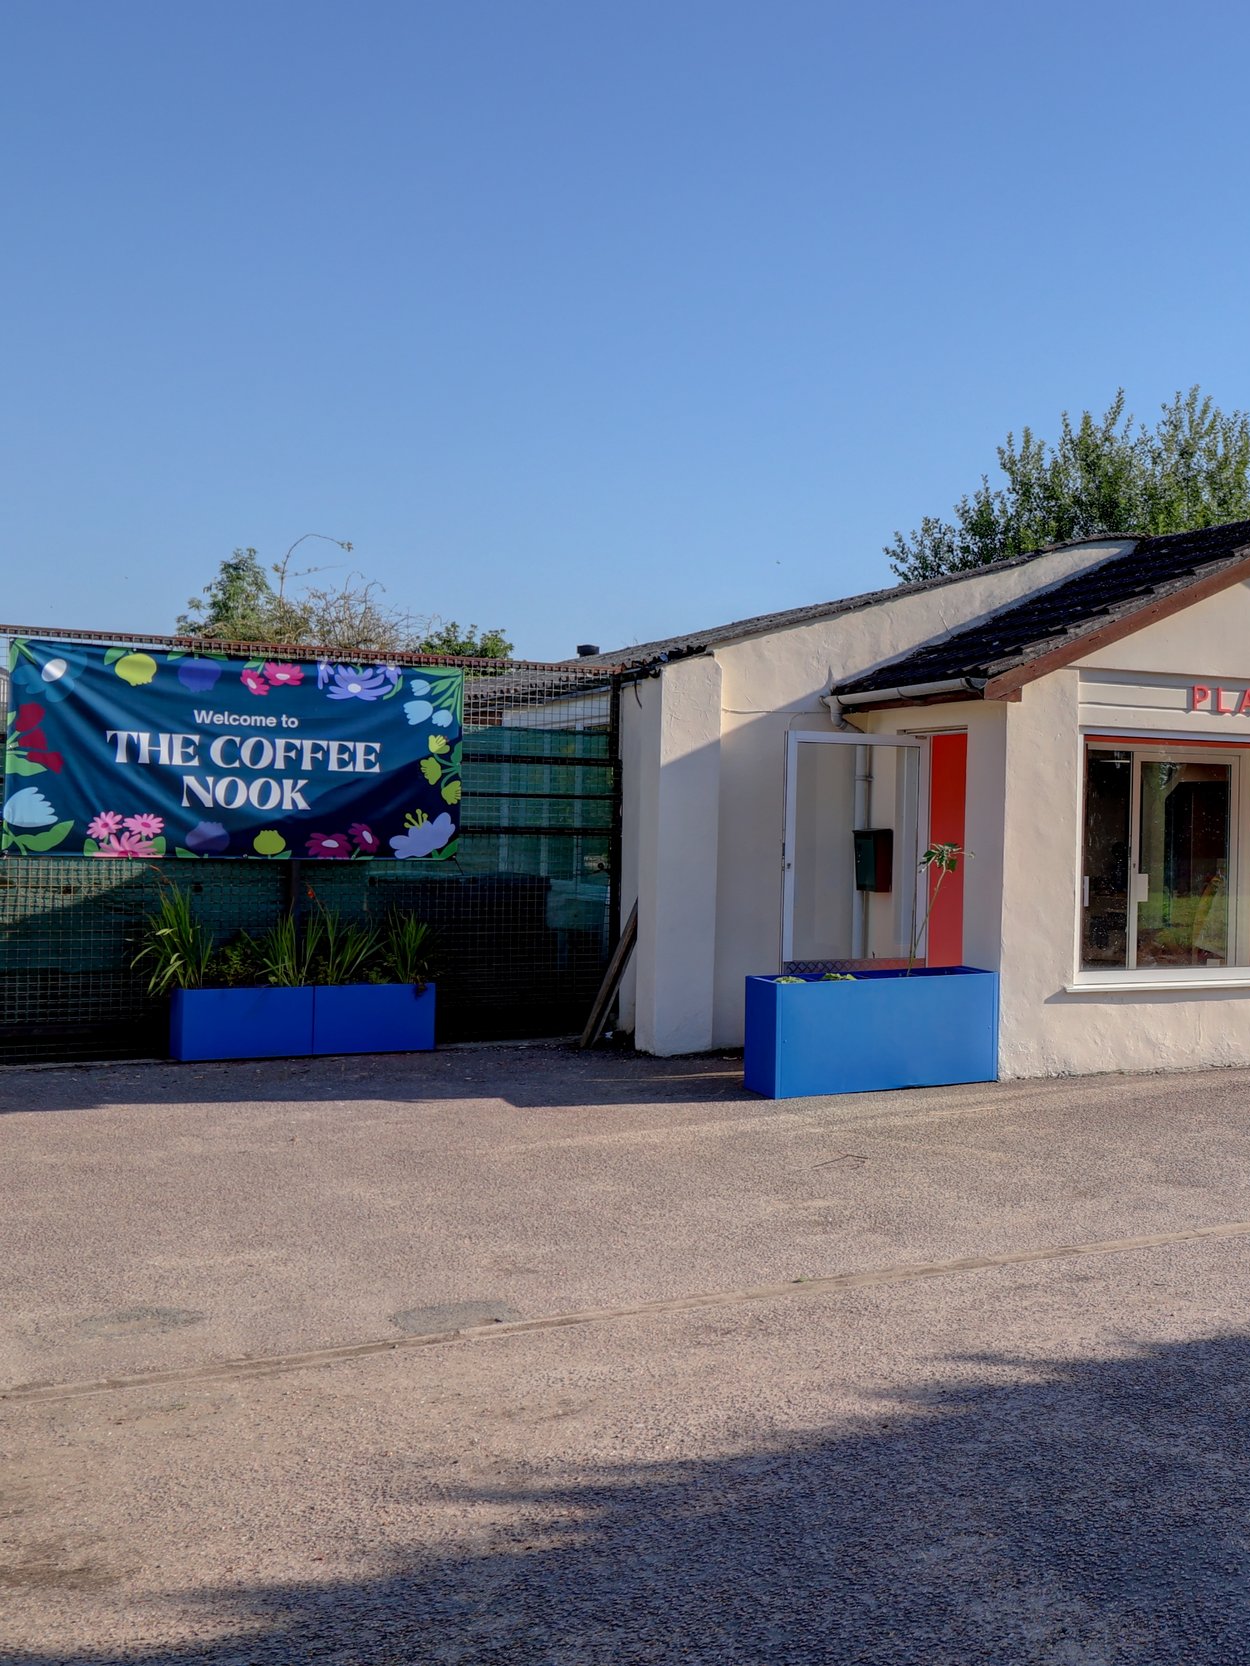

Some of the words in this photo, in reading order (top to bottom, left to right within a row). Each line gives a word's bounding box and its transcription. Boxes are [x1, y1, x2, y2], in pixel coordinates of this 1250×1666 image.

[194, 709, 277, 728] Welcome
[281, 713, 299, 729] to
[106, 730, 199, 766] THE
[210, 736, 381, 773] COFFEE
[181, 776, 311, 810] NOOK
